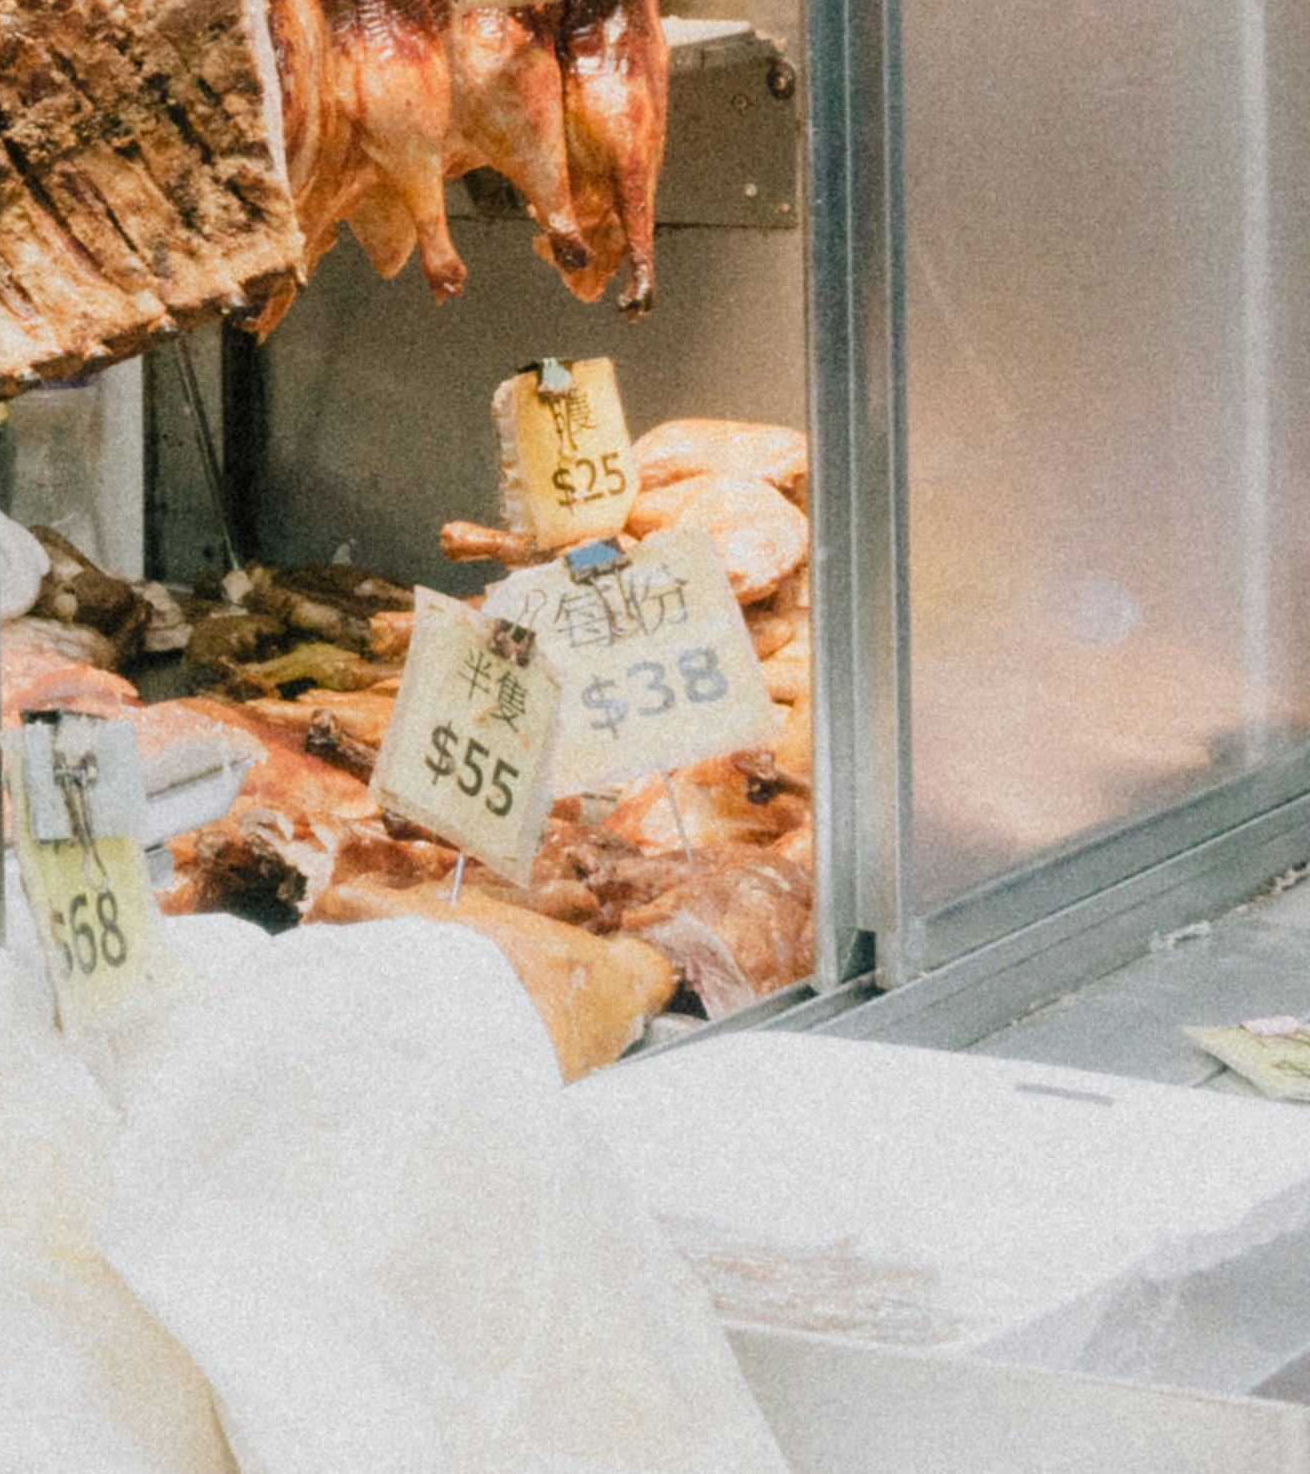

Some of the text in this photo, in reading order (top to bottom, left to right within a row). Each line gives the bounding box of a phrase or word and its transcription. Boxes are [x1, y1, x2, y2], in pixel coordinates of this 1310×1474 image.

[552, 452, 627, 516] $25
[582, 647, 730, 740] $38
[424, 720, 520, 817] $55
